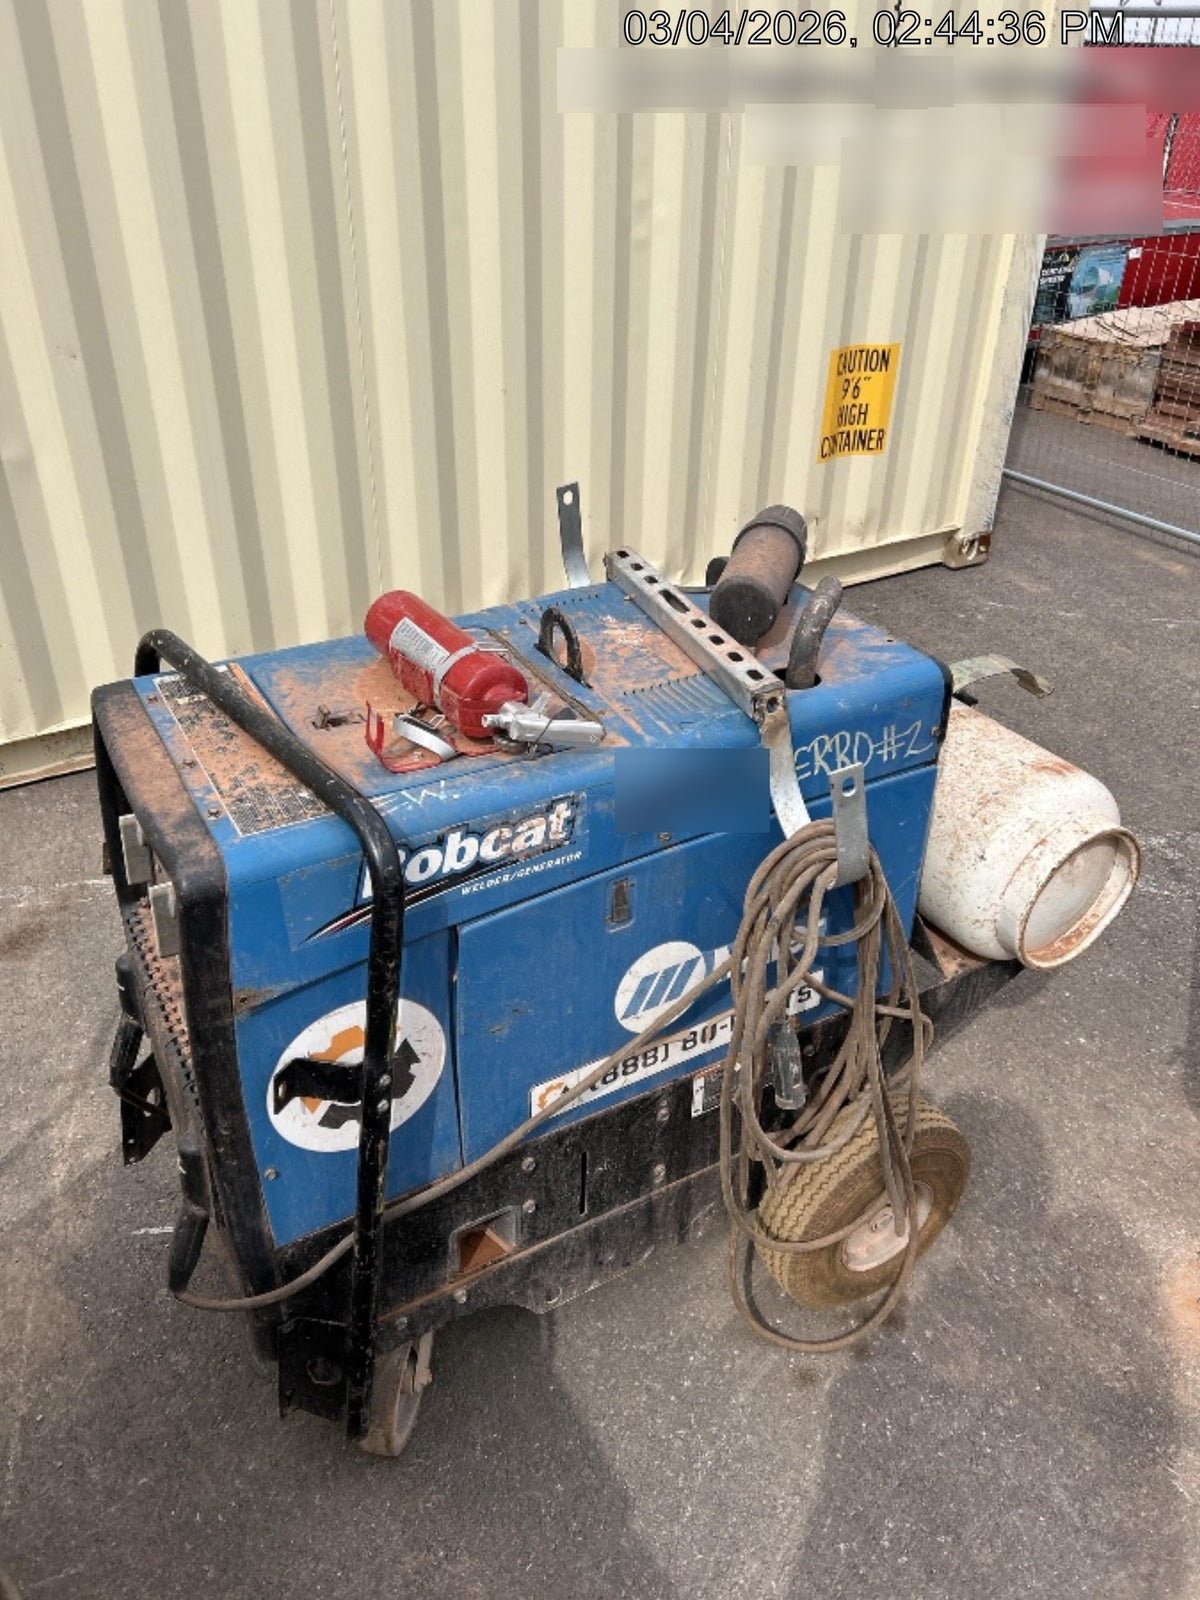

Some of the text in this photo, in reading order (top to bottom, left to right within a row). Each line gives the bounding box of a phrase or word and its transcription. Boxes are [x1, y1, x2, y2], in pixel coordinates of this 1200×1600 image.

[837, 348, 891, 376] CAUTION
[837, 403, 869, 427] HIGH
[820, 428, 885, 459] CONTAINER
[460, 850, 583, 896] WELDER/GENERATOR
[589, 1043, 671, 1093] 888)
